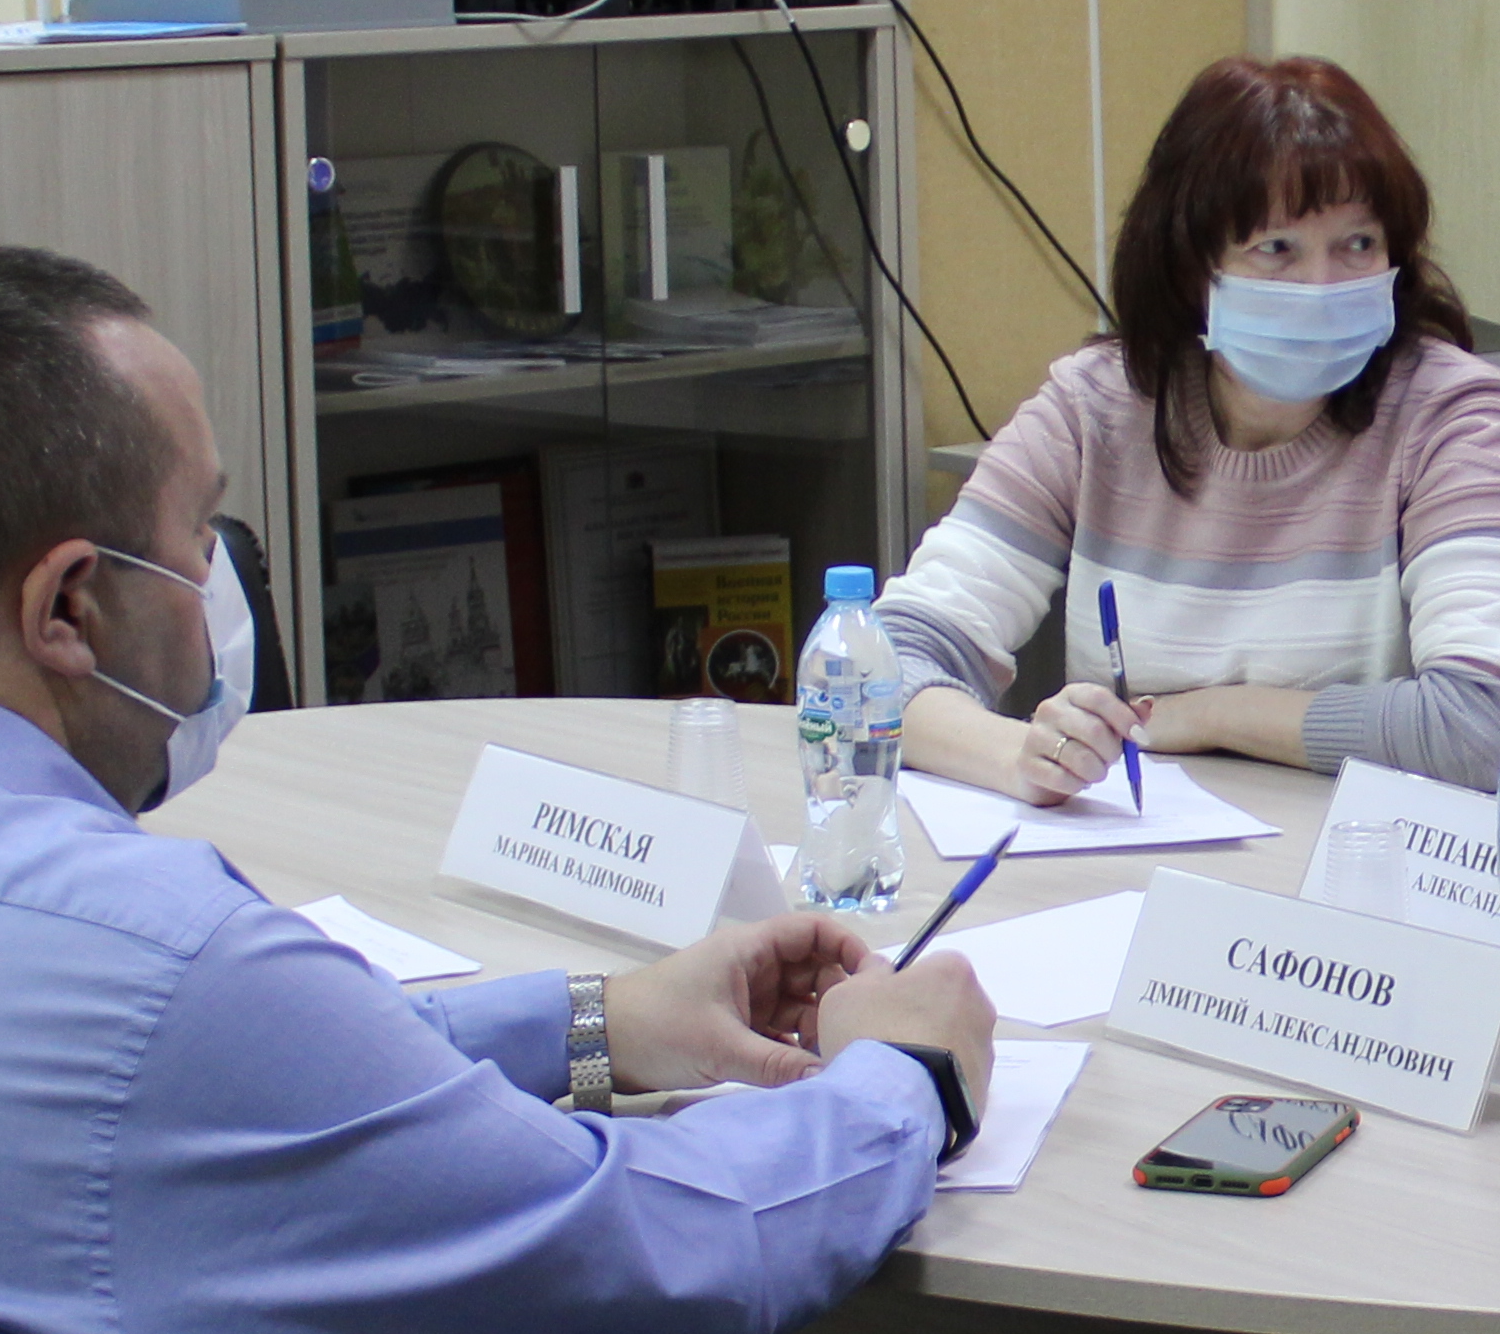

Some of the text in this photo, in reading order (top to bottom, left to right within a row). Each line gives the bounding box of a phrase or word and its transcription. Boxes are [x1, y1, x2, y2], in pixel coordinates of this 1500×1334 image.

[531, 801, 655, 864] РИМСКАЯ
[493, 834, 665, 908] МАРИНА ВАДИМОВНА
[1227, 937, 1396, 1008] САФОНОВ
[1138, 979, 1249, 1027] ДМИТРИЙ
[1250, 1010, 1455, 1082] АЛЕКСАНДРОВИЧ
